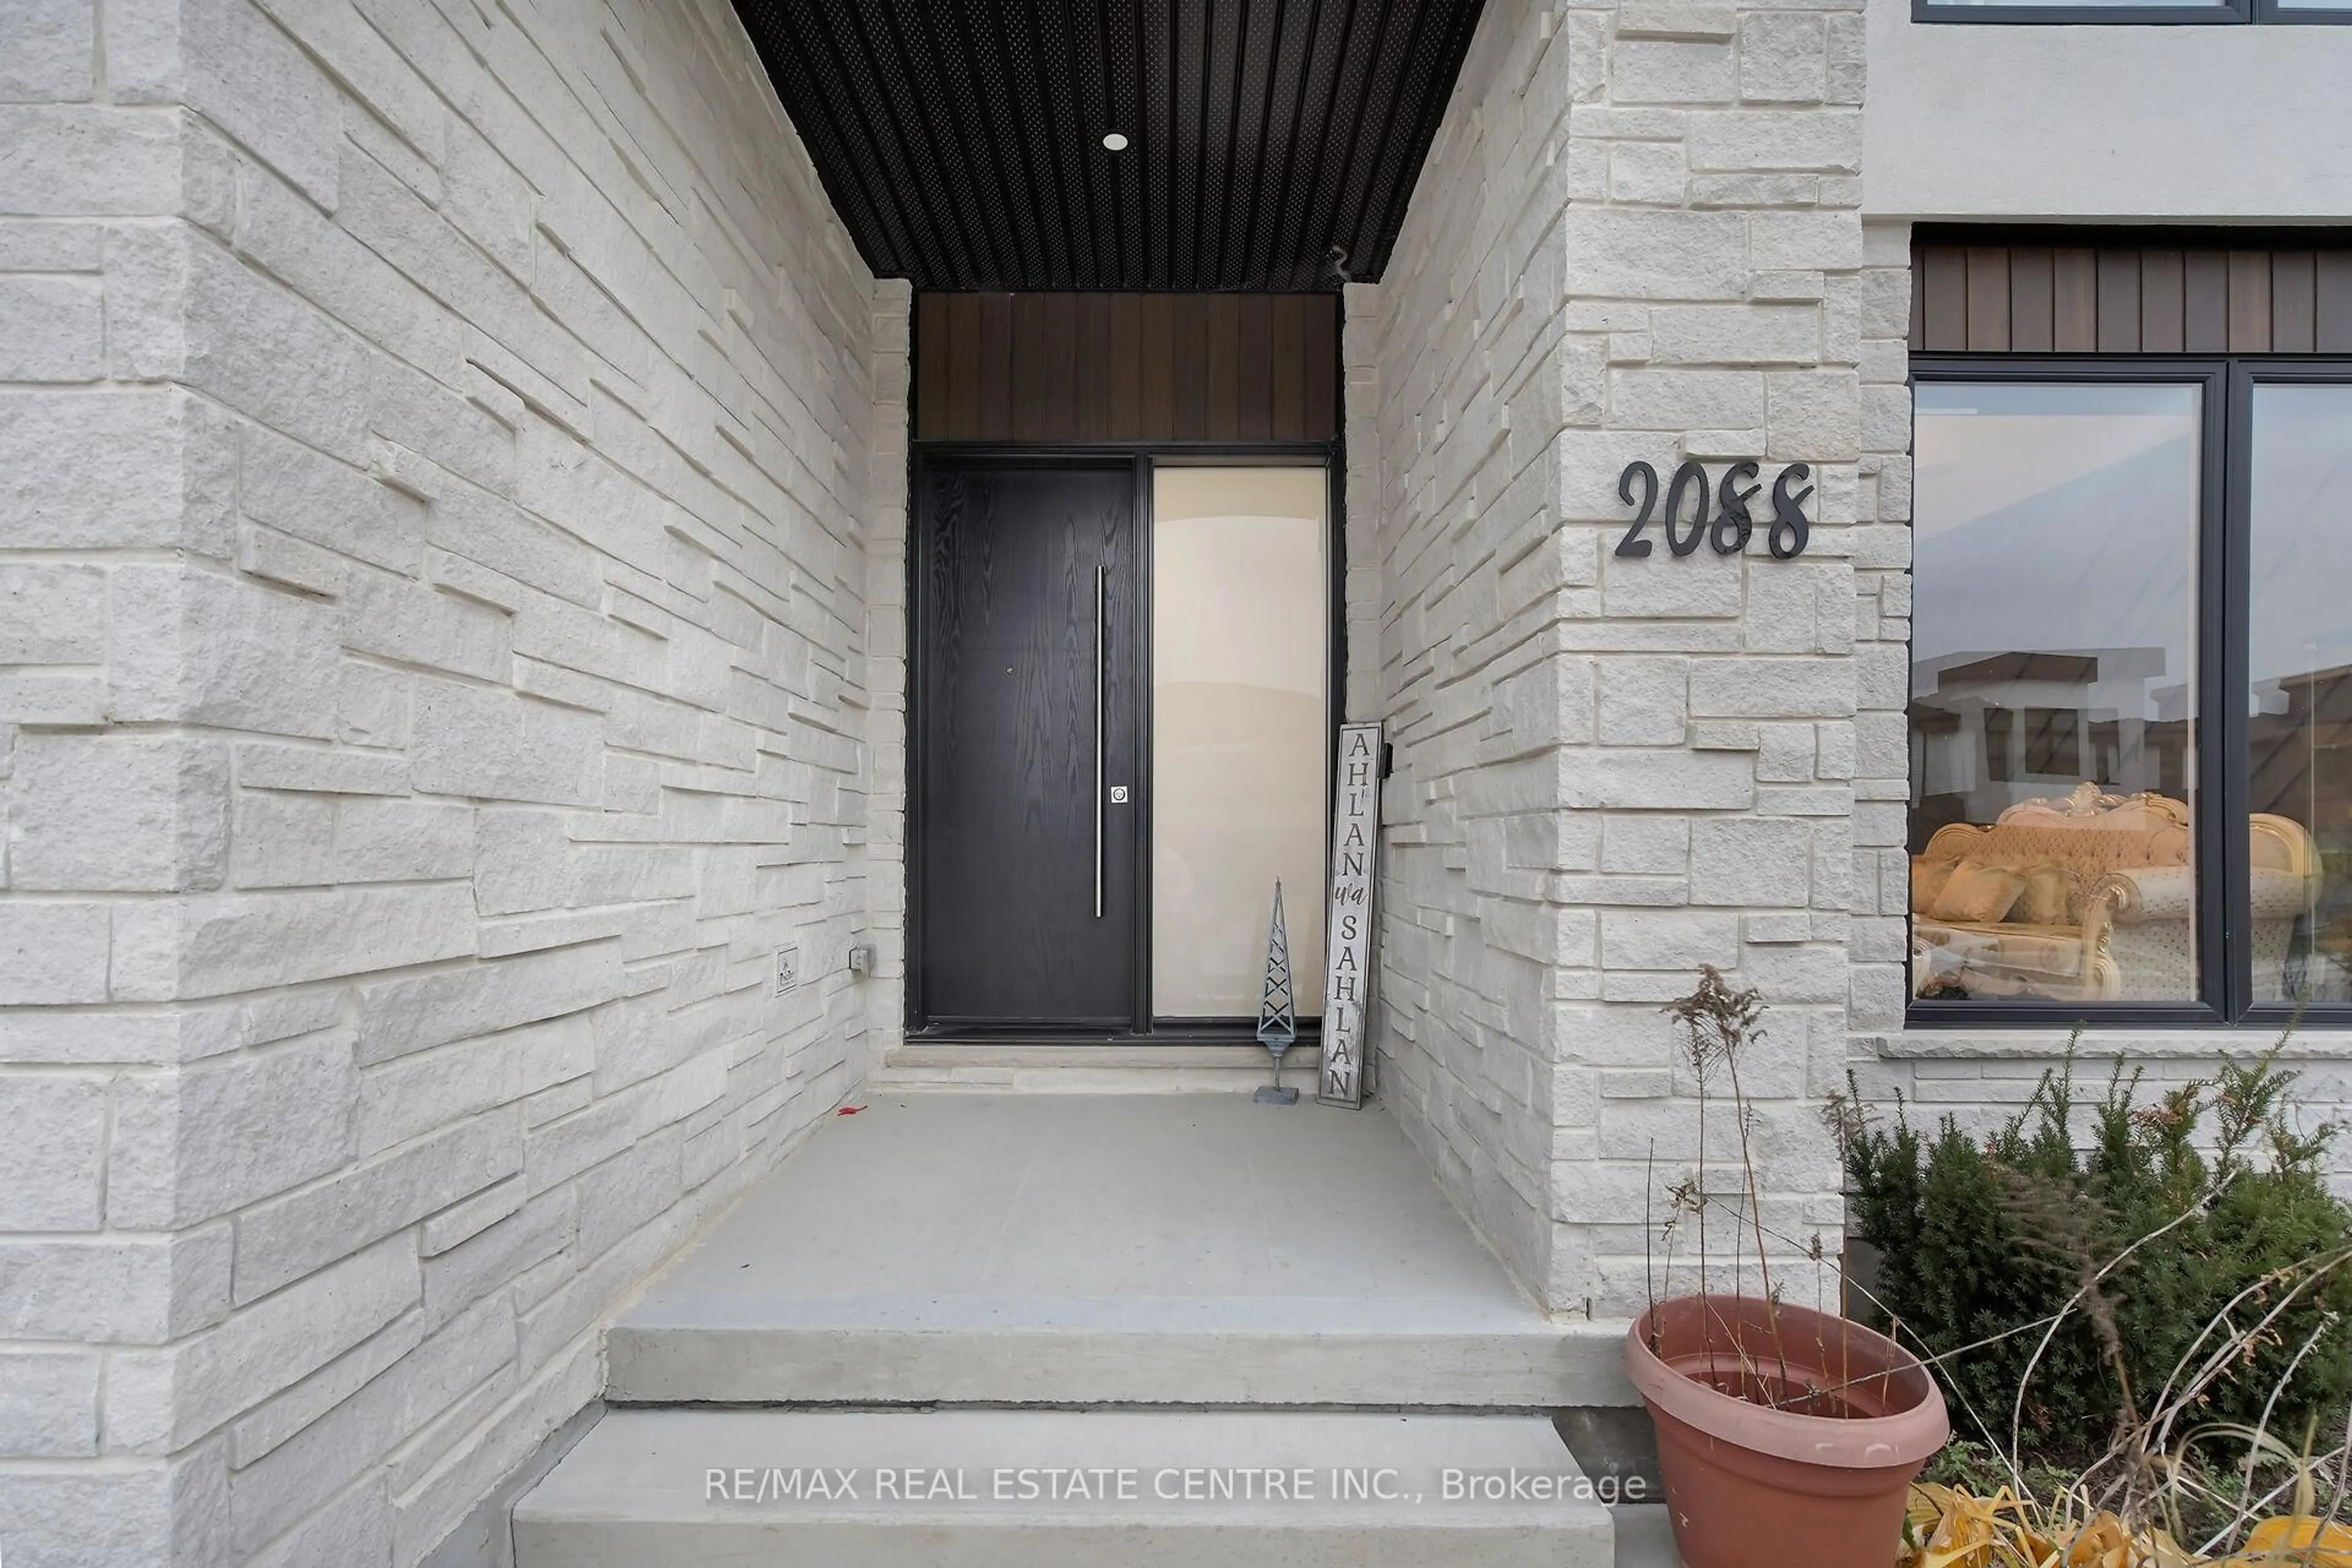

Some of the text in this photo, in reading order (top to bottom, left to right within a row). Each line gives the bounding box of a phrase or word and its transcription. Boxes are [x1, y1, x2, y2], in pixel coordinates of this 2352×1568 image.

[1615, 460, 1815, 560] 2088
[1342, 733, 1370, 876] AHLAN
[1329, 915, 1357, 1096] SAHLAN
